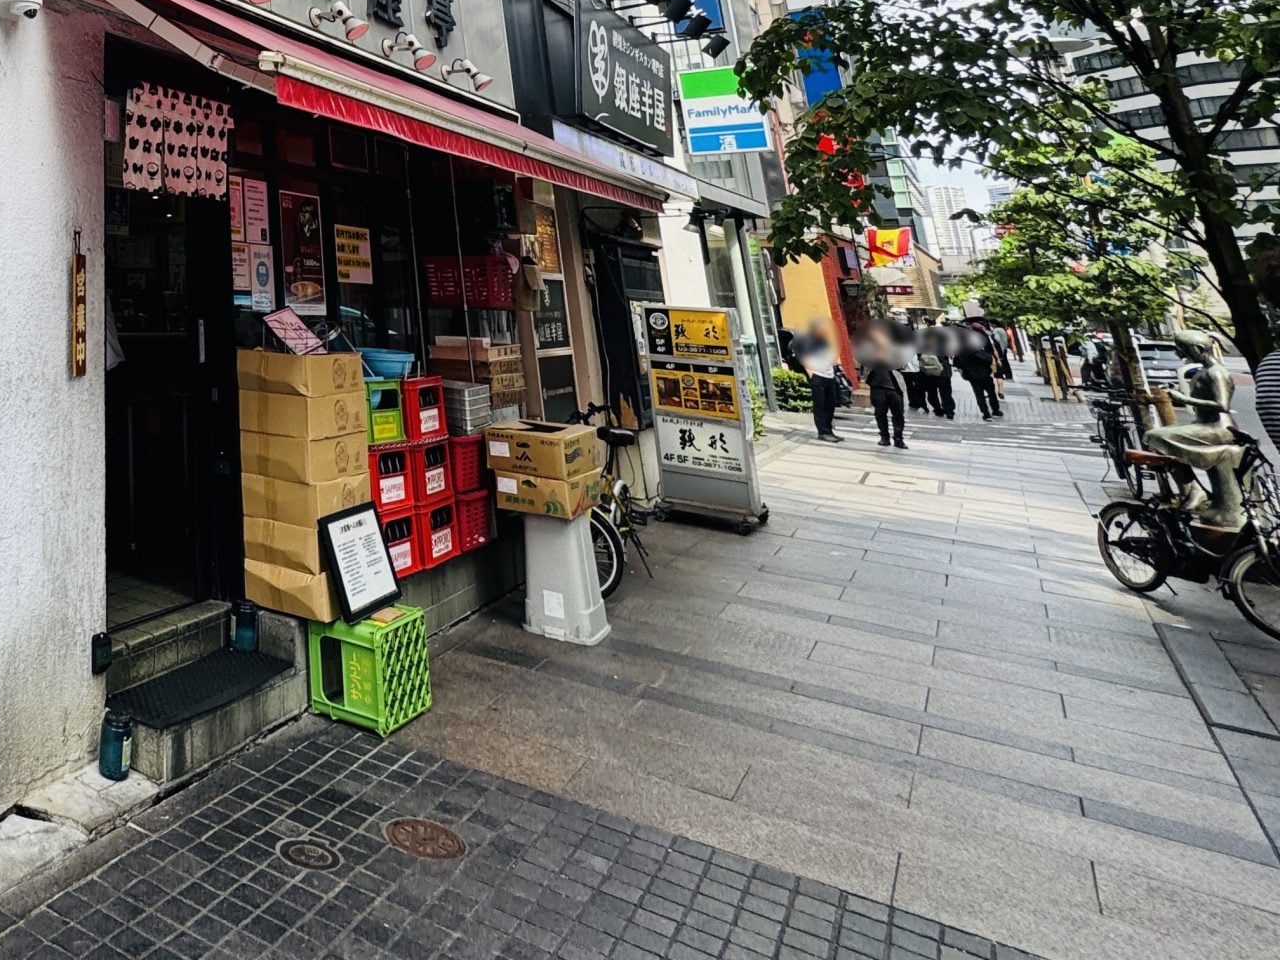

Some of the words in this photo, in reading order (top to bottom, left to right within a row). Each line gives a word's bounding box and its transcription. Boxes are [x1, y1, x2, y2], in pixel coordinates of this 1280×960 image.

[613, 62, 666, 132] 銀座羊屋
[719, 135, 737, 151] 酒
[663, 452, 675, 462] 4F
[677, 454, 689, 465] 5F
[349, 652, 362, 700] サントリー
